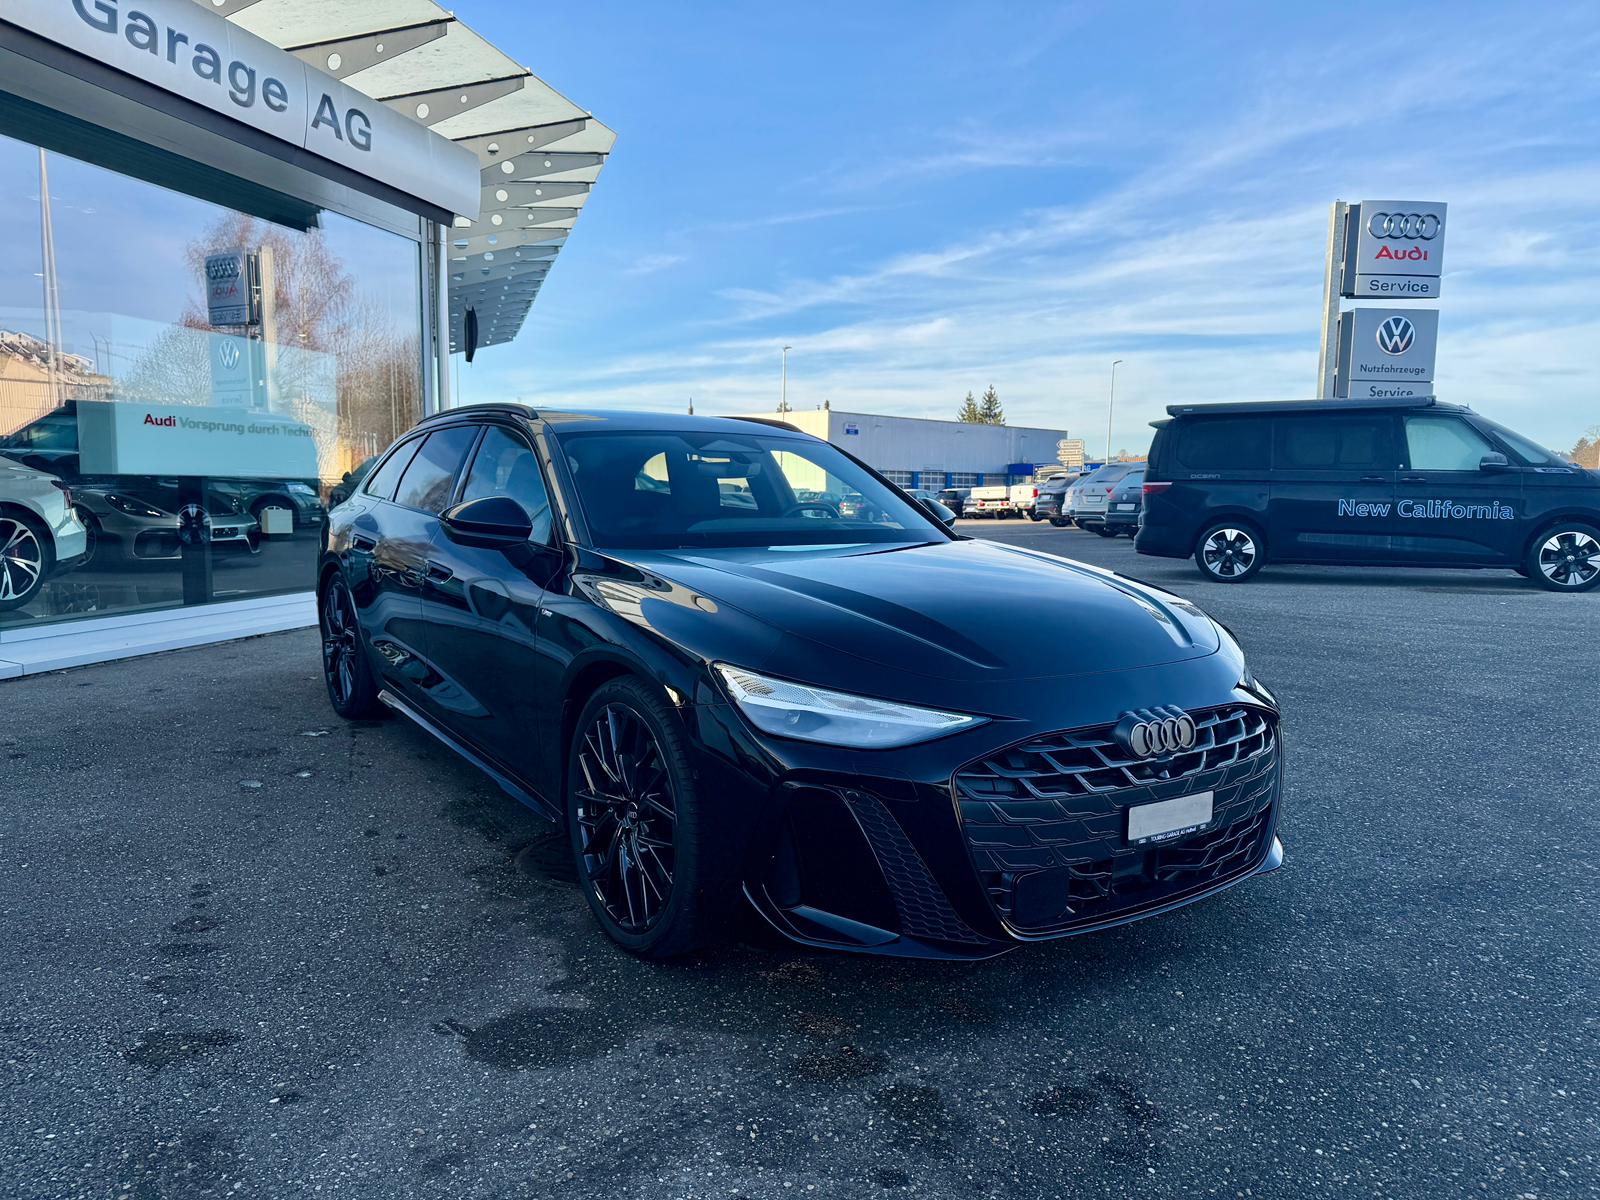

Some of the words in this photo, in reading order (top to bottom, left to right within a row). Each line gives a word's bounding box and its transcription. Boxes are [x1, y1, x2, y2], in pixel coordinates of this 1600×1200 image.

[71, 0, 289, 112] Garage
[311, 93, 372, 152] AG
[1375, 245, 1428, 261] Audi
[1369, 279, 1430, 293] Service
[1360, 364, 1425, 374] Nutzfahrzeuge
[1369, 386, 1413, 396] Service
[144, 413, 176, 427] Audi
[179, 416, 245, 435] Vorsprung
[247, 423, 279, 435] durch
[1338, 499, 1390, 517] New
[1397, 499, 1514, 520] California
